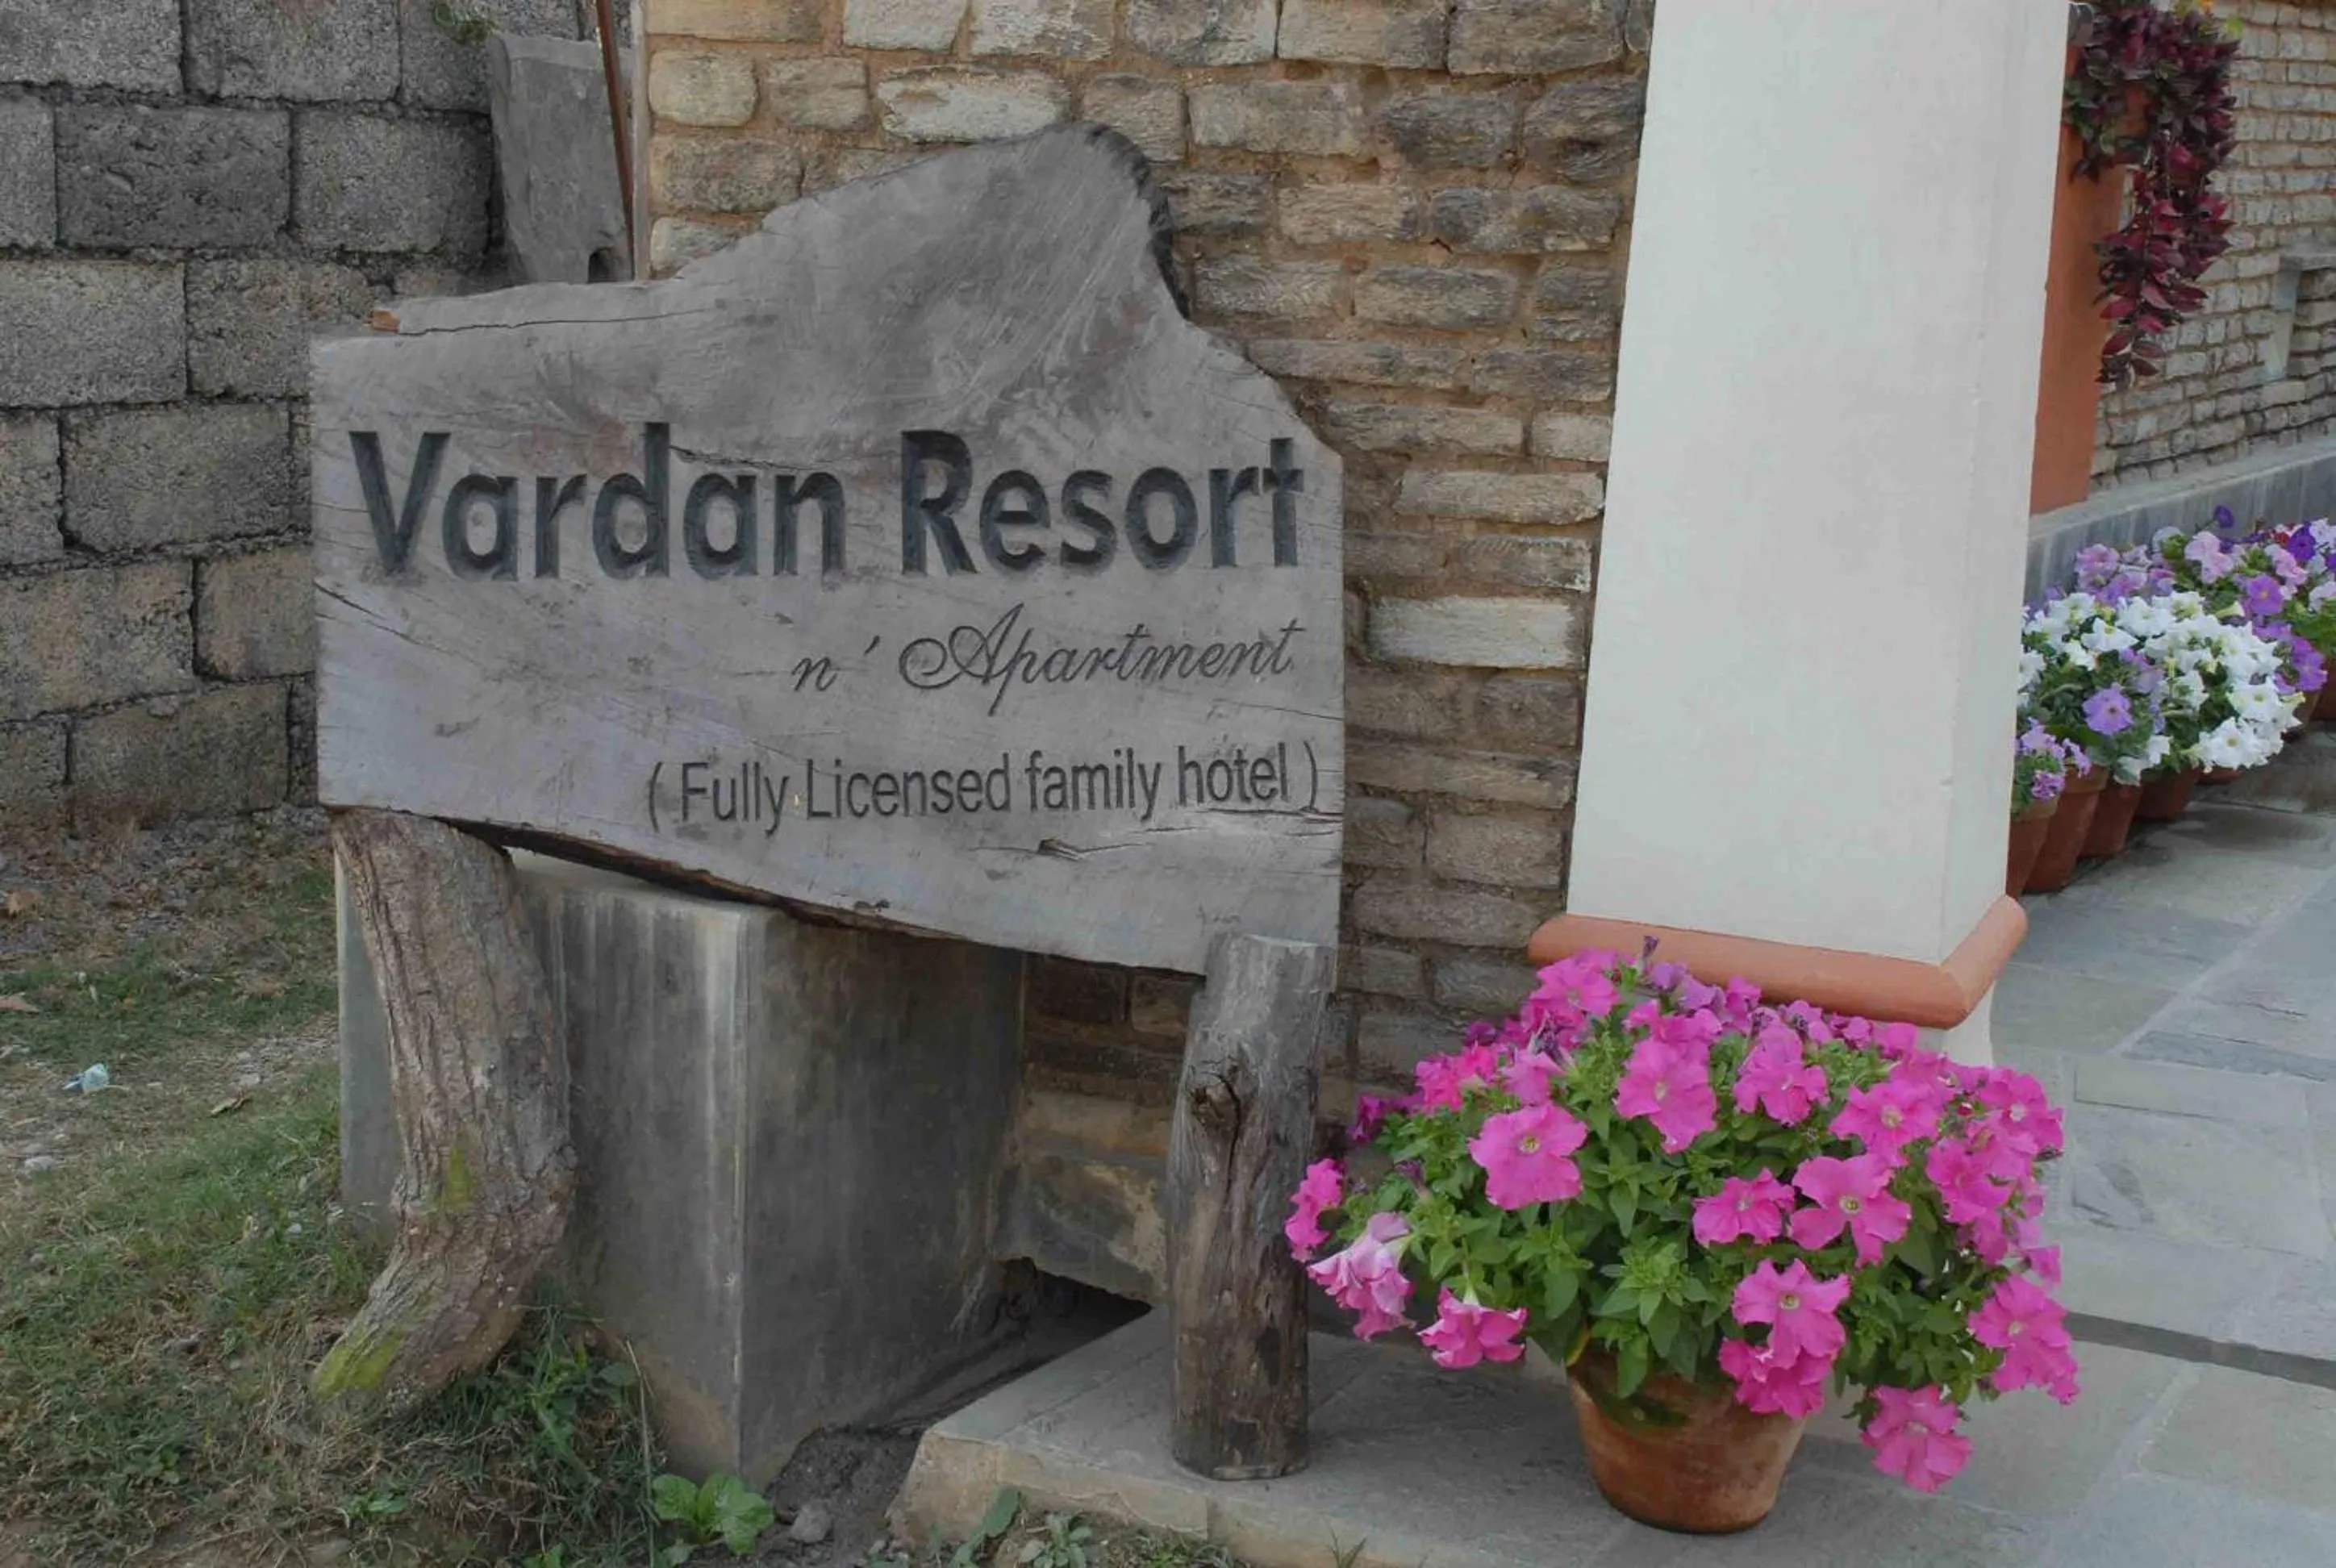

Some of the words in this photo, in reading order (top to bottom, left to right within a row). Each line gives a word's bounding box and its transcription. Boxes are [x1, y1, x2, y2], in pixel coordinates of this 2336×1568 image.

[348, 421, 848, 582] Vardan
[899, 428, 1305, 576] Resort
[898, 602, 1307, 717] Apartment
[806, 750, 1012, 821] Licensed
[1024, 747, 1163, 824] family
